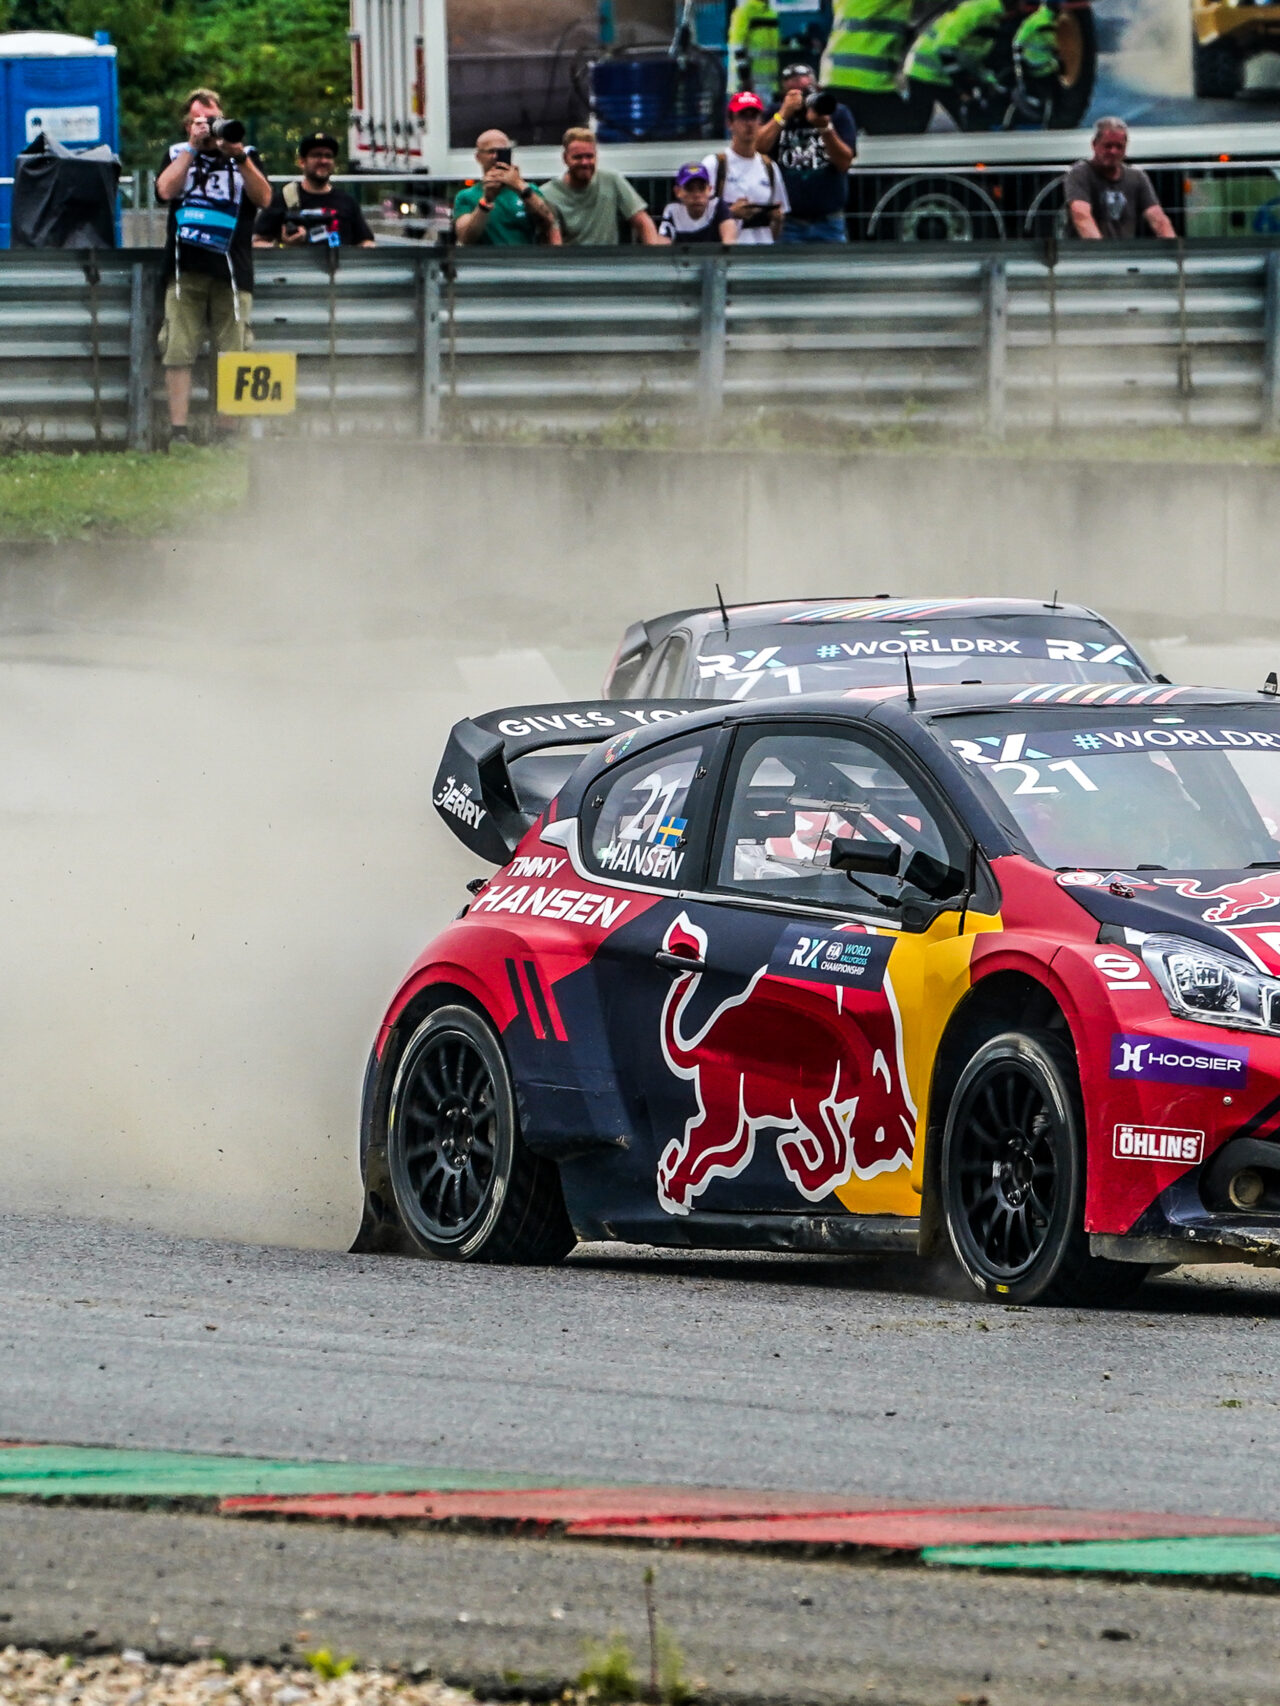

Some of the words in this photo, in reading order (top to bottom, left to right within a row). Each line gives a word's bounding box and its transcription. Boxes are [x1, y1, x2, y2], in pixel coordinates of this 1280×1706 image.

[696, 646, 787, 678] RX
[816, 638, 1022, 658] #WORLDRX
[1046, 639, 1136, 667] RX
[725, 666, 802, 700] 71
[498, 711, 615, 737] GIVES
[619, 709, 700, 726] YO
[949, 733, 1053, 765] RX
[460, 783, 473, 796] THE
[990, 760, 1099, 795] 21
[617, 773, 682, 843] 21
[507, 856, 567, 879] TIMMY
[600, 840, 685, 880] HANSEN
[471, 885, 631, 929] HANSEN
[789, 936, 828, 969] RX
[844, 944, 872, 957] WORLD
[820, 961, 865, 976] CHAMPIONSHIP
[840, 955, 868, 966] RALLYCROSS
[1148, 1053, 1242, 1072] HOOSIER
[1119, 1127, 1198, 1160] ÖHLINS
